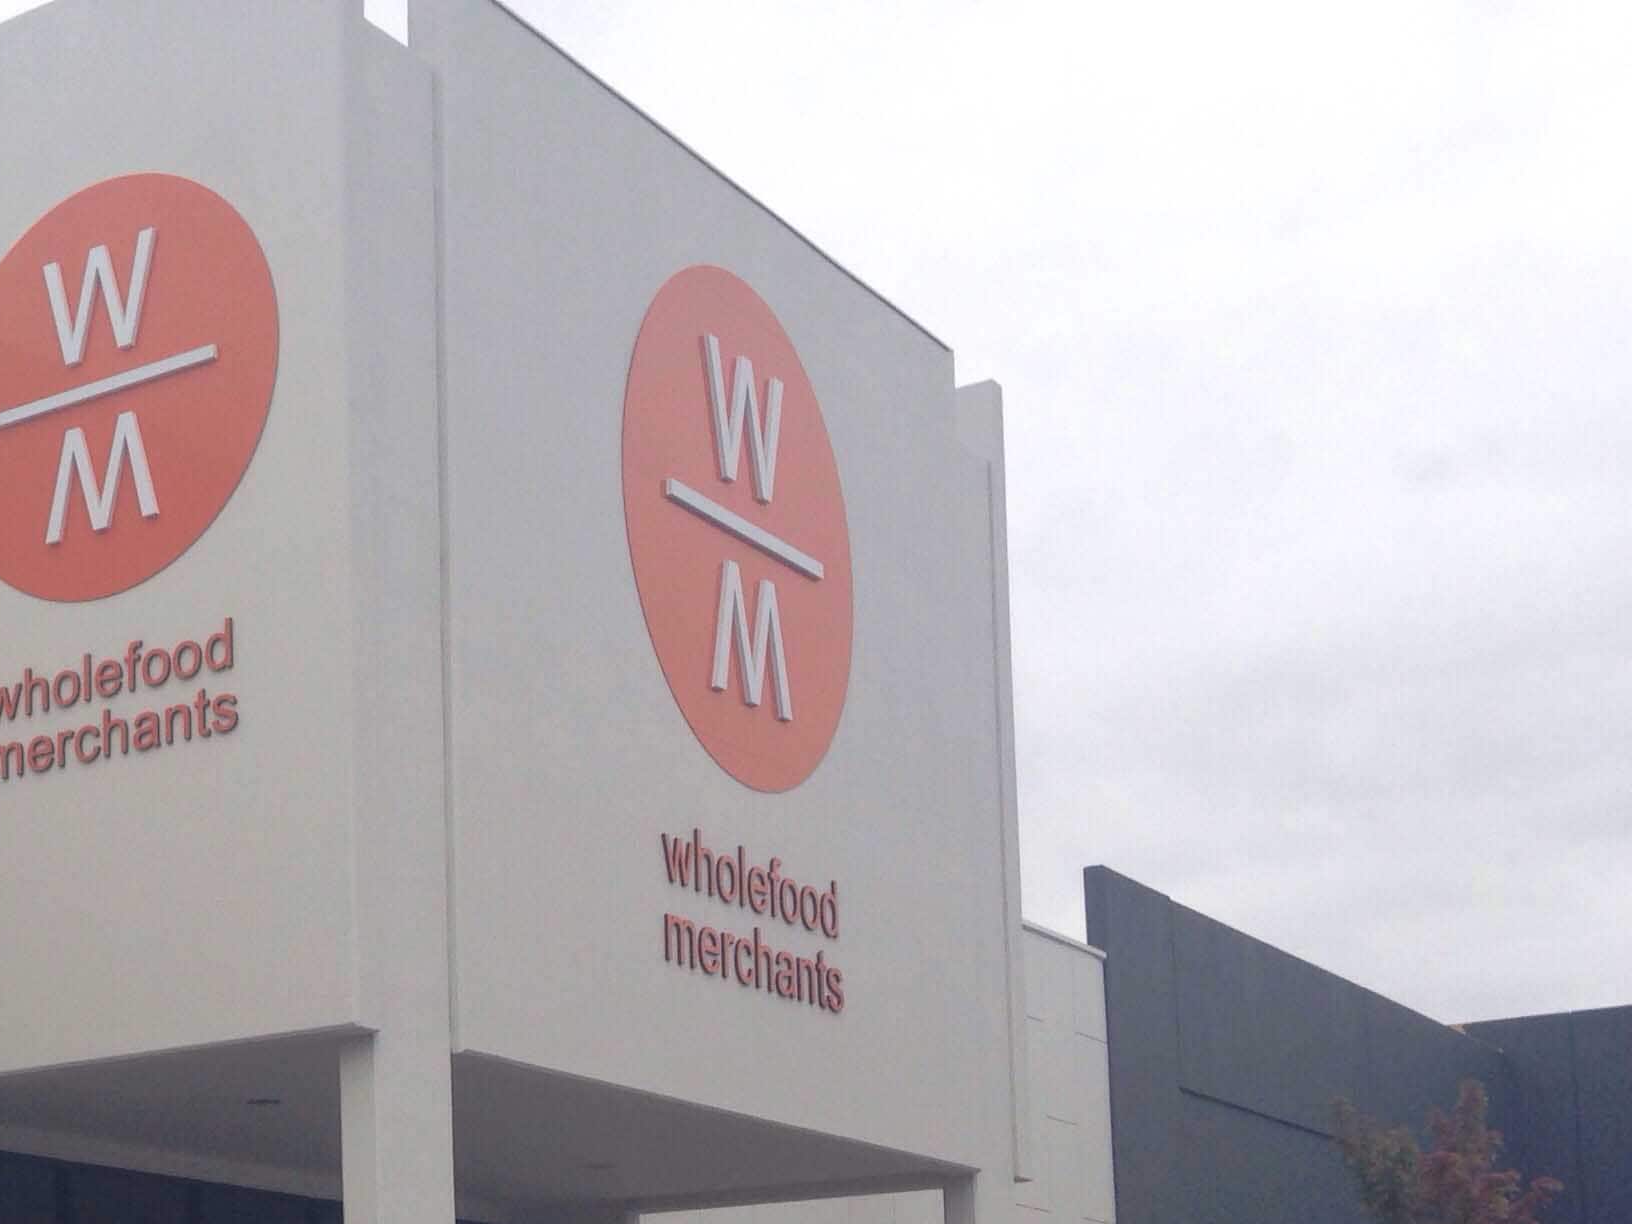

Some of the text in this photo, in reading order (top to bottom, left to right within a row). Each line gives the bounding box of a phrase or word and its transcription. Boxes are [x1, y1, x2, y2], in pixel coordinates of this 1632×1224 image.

[42, 226, 156, 366] W
[45, 410, 159, 546] M
[699, 332, 784, 505] W
[711, 559, 792, 722] M
[661, 827, 839, 940] wholefood
[663, 910, 844, 1014] merchants
